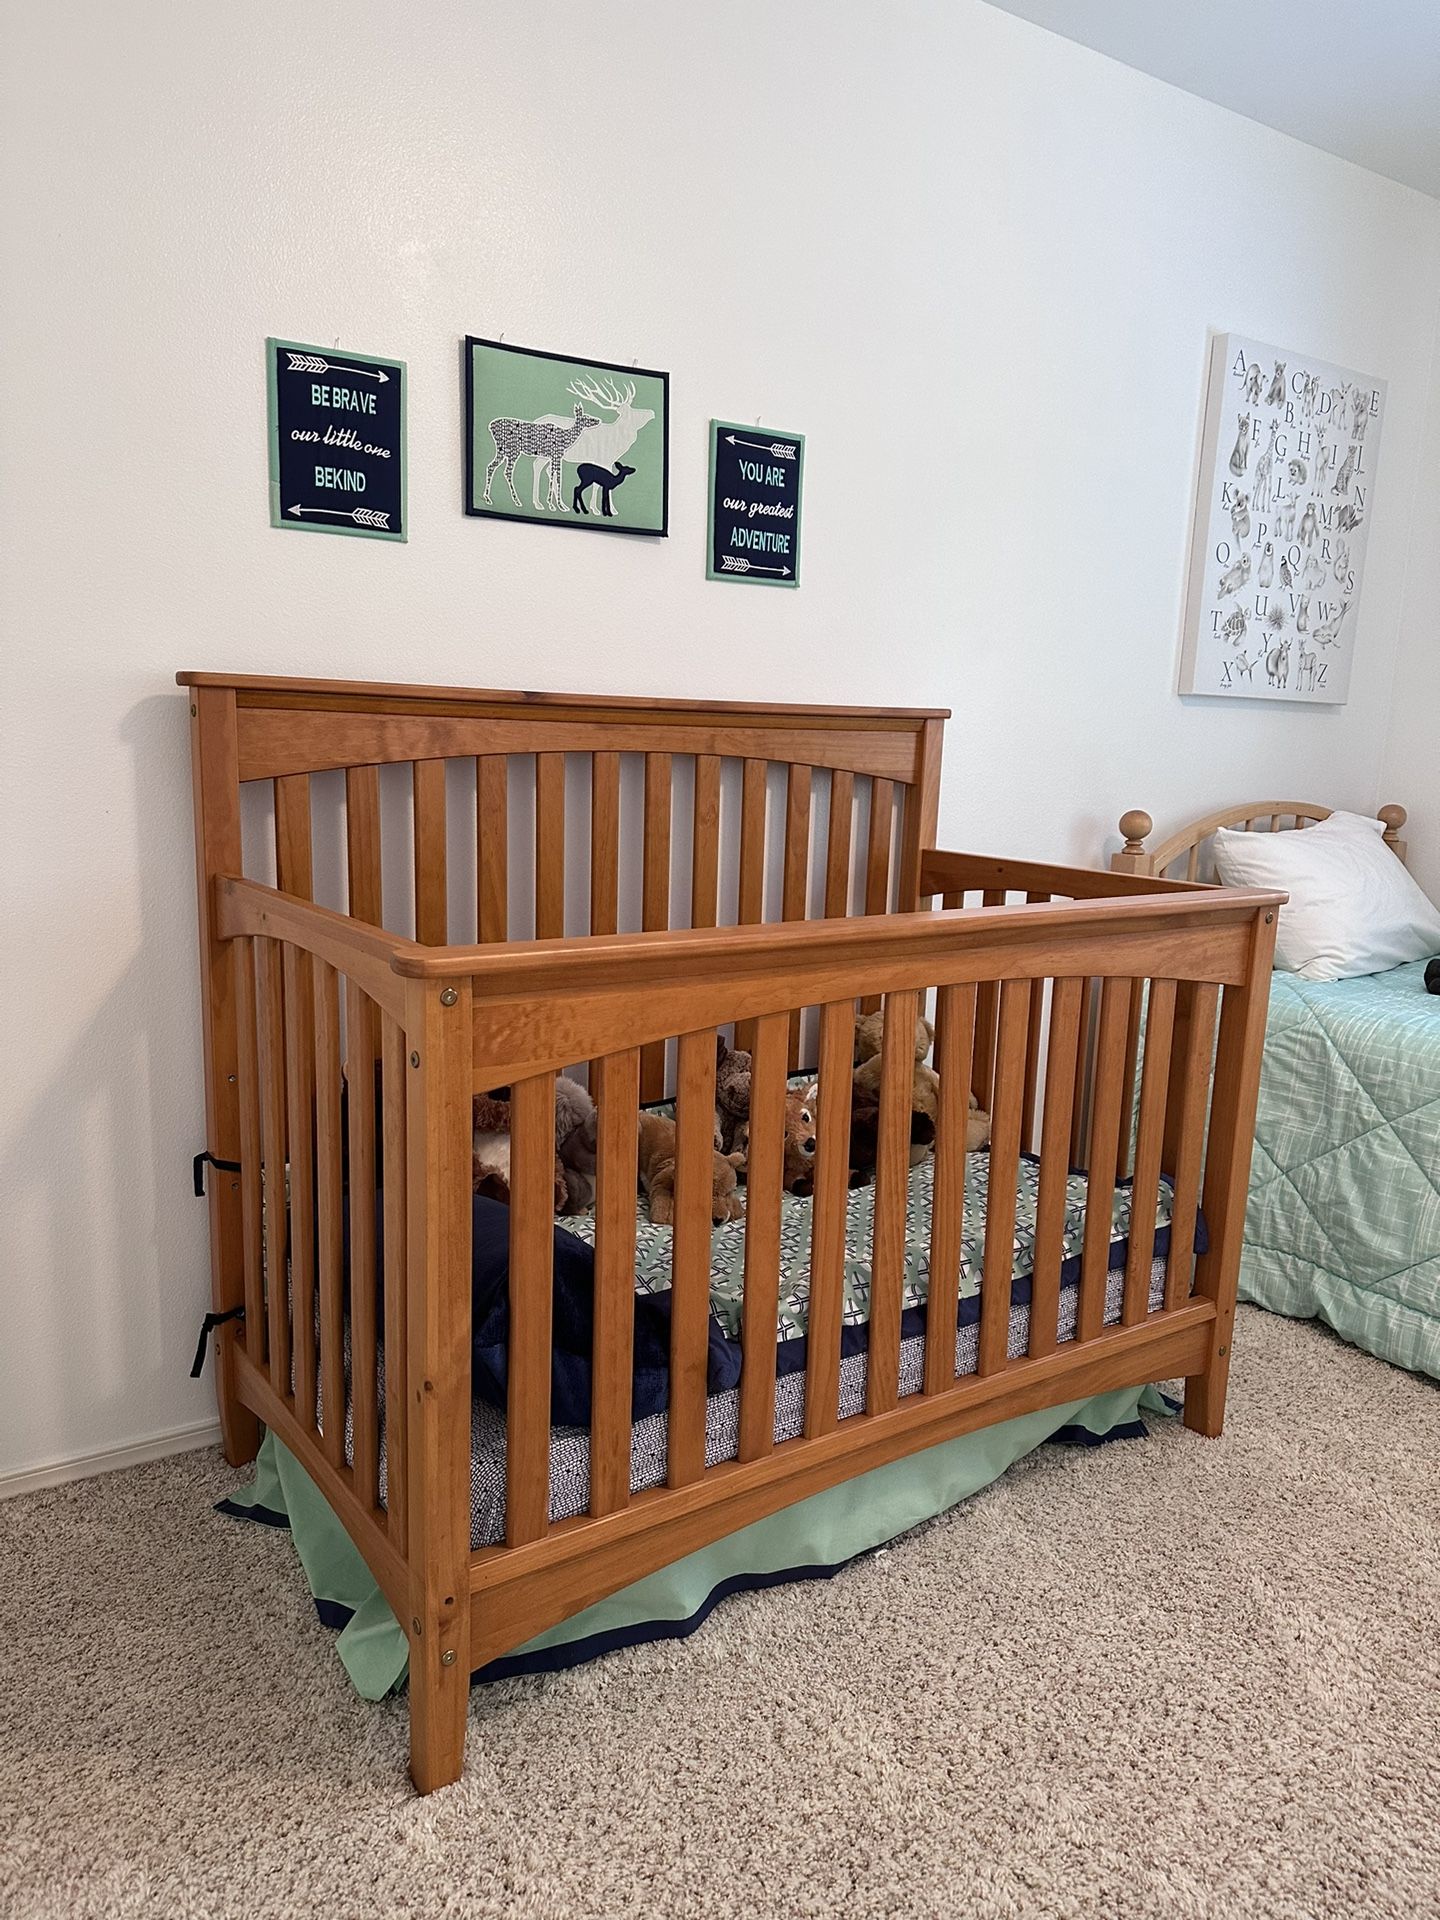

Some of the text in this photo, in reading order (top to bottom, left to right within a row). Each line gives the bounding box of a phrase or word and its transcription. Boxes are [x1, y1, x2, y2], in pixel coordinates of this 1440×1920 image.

[1232, 349, 1246, 372] A
[1291, 372, 1304, 394] C
[311, 384, 377, 415] BE BRAVE
[1320, 392, 1332, 414] D
[1370, 390, 1379, 412] E
[1284, 401, 1294, 423] B
[1252, 418, 1262, 441] F
[291, 425, 391, 458] our little one
[1274, 434, 1288, 457] G
[1298, 431, 1311, 454] H
[1332, 444, 1338, 465] I
[1354, 445, 1363, 472] J
[739, 459, 785, 487] YOU ARE
[1222, 482, 1234, 503] K
[1277, 477, 1285, 499] L
[1354, 486, 1366, 507] N
[723, 497, 794, 518] our greatest
[1319, 503, 1334, 525] M
[730, 526, 790, 553] ADVENTURE
[1257, 522, 1268, 544] P
[1216, 542, 1230, 564] O
[1288, 545, 1301, 572] Q
[1321, 538, 1332, 559] R
[1346, 570, 1355, 591] S
[1255, 595, 1268, 617] U
[1289, 593, 1301, 613] V
[1318, 601, 1332, 622] W
[1211, 610, 1222, 632] T
[1262, 632, 1273, 653] Y
[1221, 661, 1233, 682] X
[1318, 663, 1328, 683] Z
